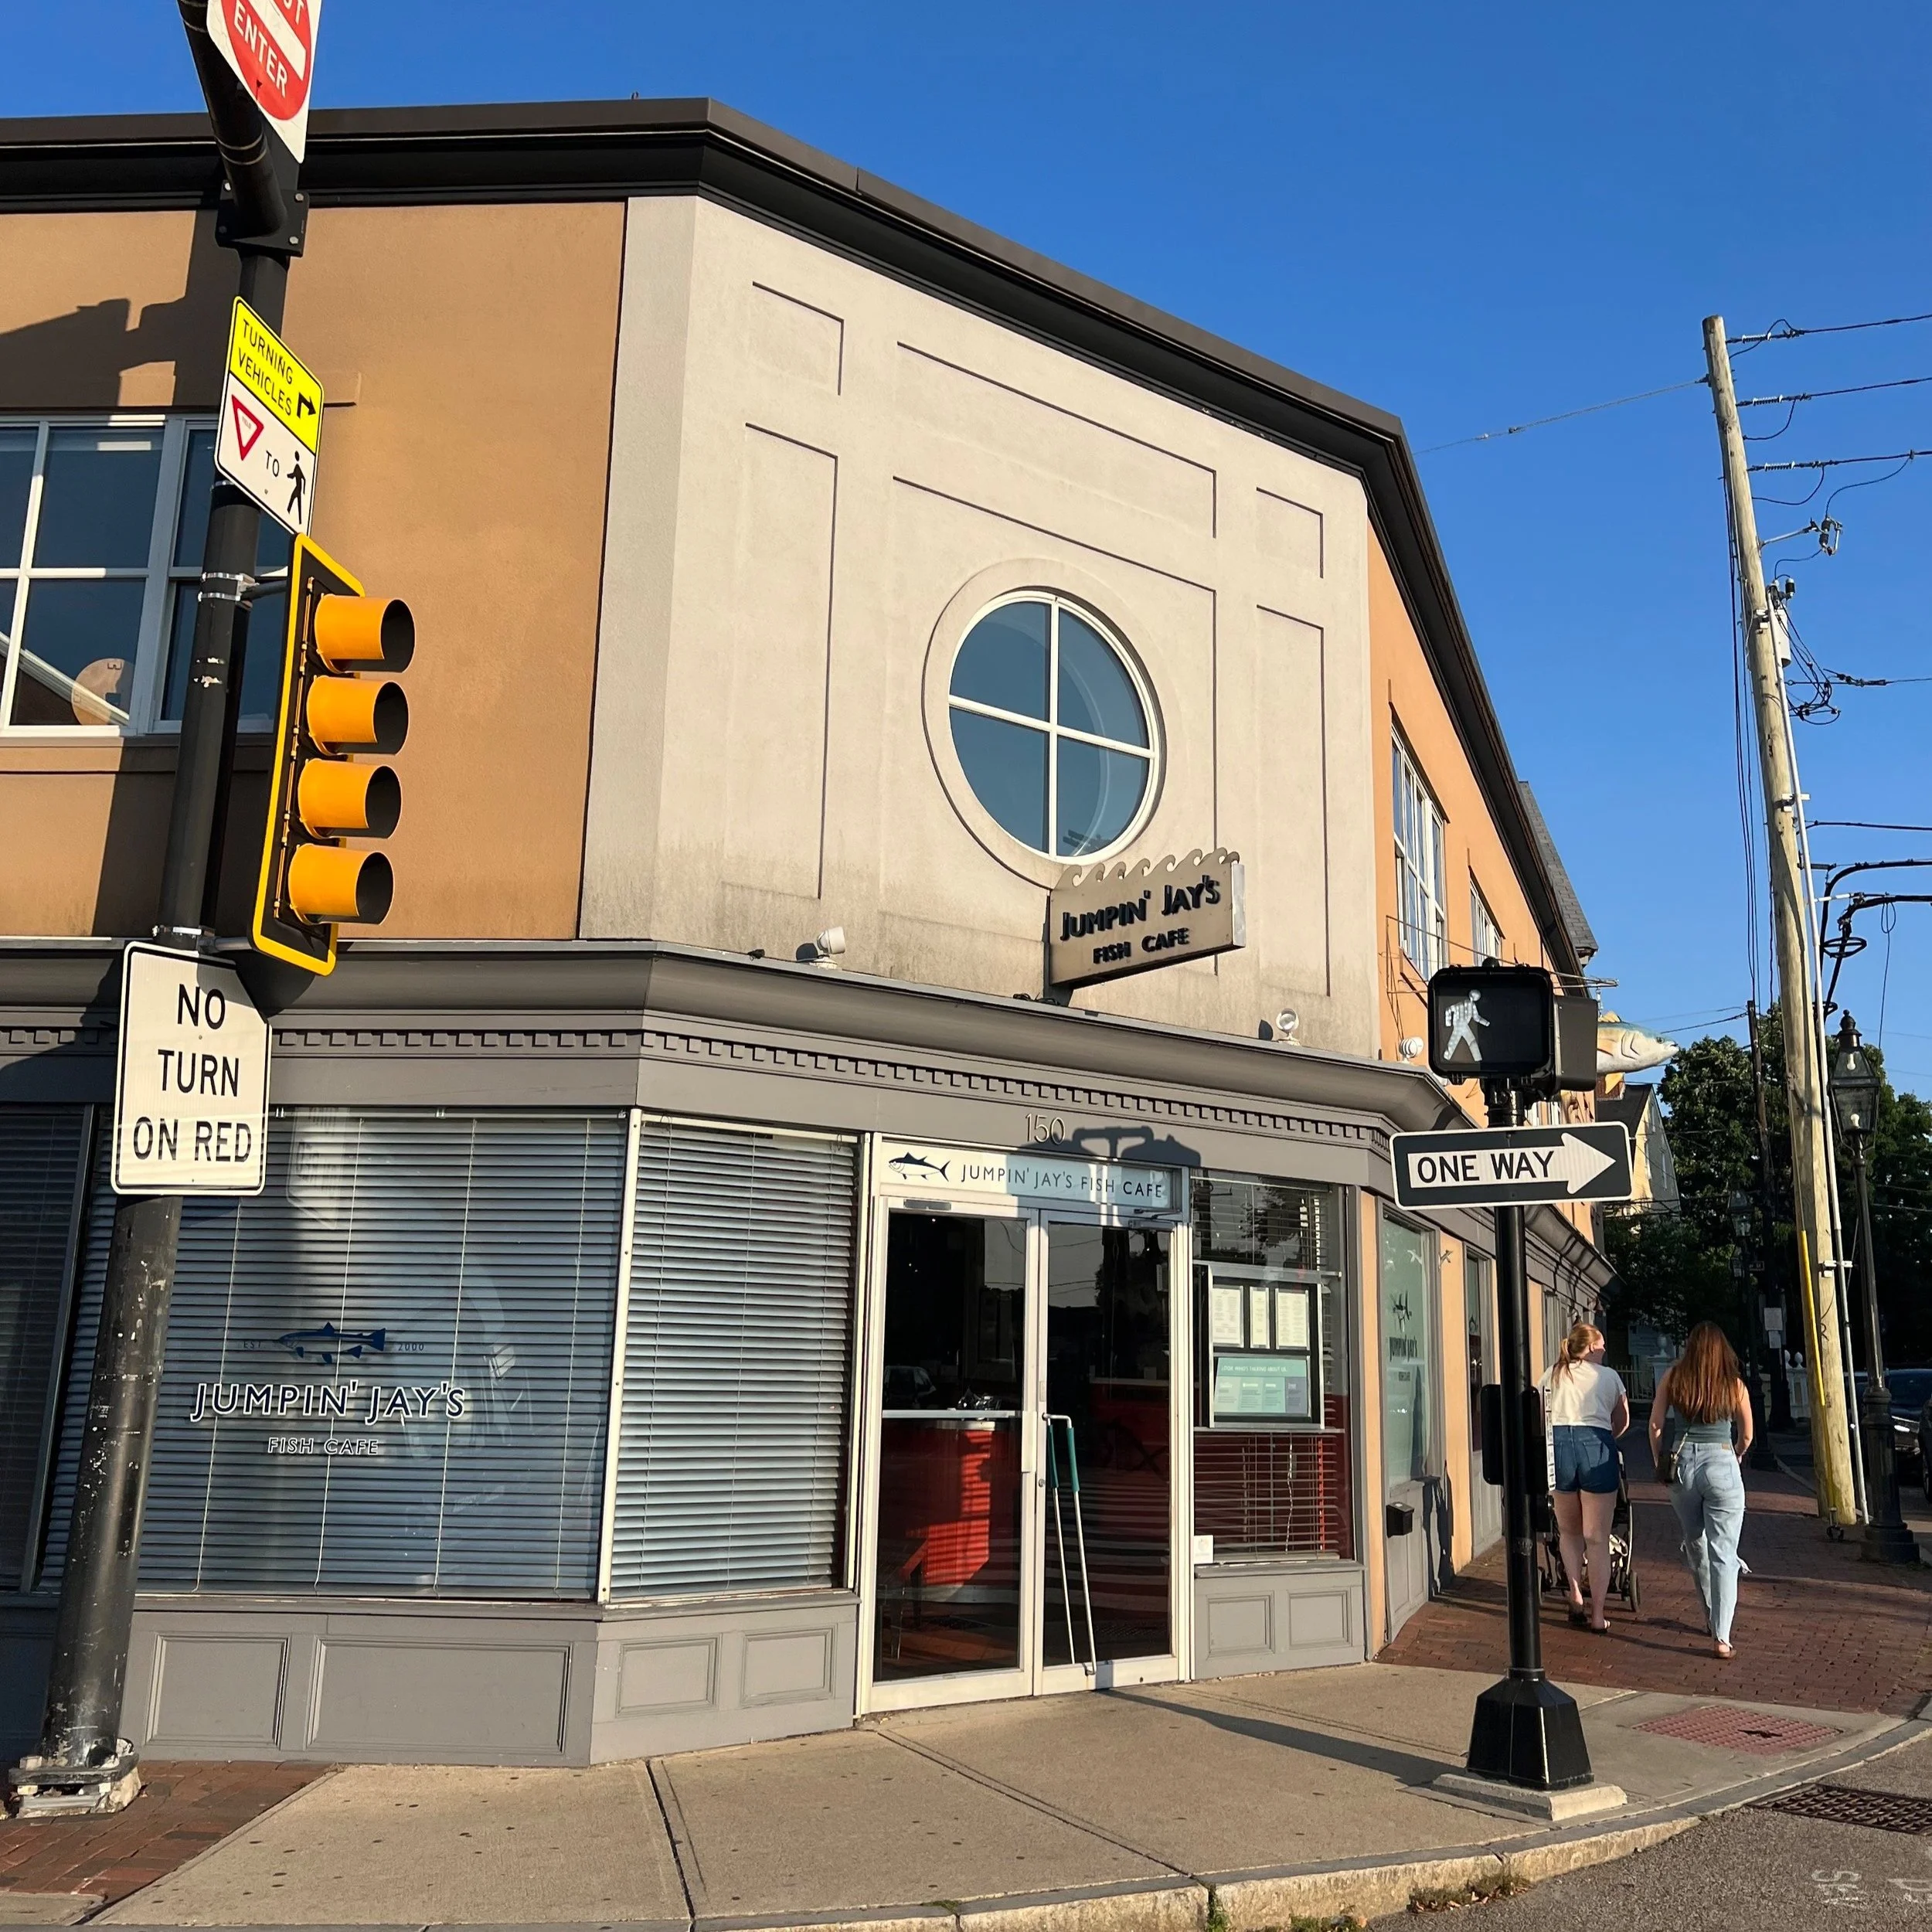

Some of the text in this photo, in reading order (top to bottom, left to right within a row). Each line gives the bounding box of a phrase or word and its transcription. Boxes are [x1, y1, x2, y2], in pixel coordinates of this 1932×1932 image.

[234, 0, 288, 99] ENTER
[243, 318, 293, 385] TURNING
[239, 347, 292, 417] VEHICLES
[265, 450, 280, 478] TO
[1060, 875, 1219, 941] JUMPIN' JAY'S
[1093, 927, 1190, 964] FISH CAFE
[177, 983, 226, 1029] NO
[158, 1049, 239, 1097] TURN
[134, 1116, 179, 1161] ON
[195, 1121, 251, 1162] RED
[1025, 1113, 1066, 1146] 150
[961, 1164, 1162, 1198] JUMPIN' JAY'S FISH CAFE
[1417, 1151, 1555, 1183] ONE WAY
[190, 1379, 465, 1427] JUMPIN' JAY'S
[267, 1437, 379, 1455] FISH CAFE
